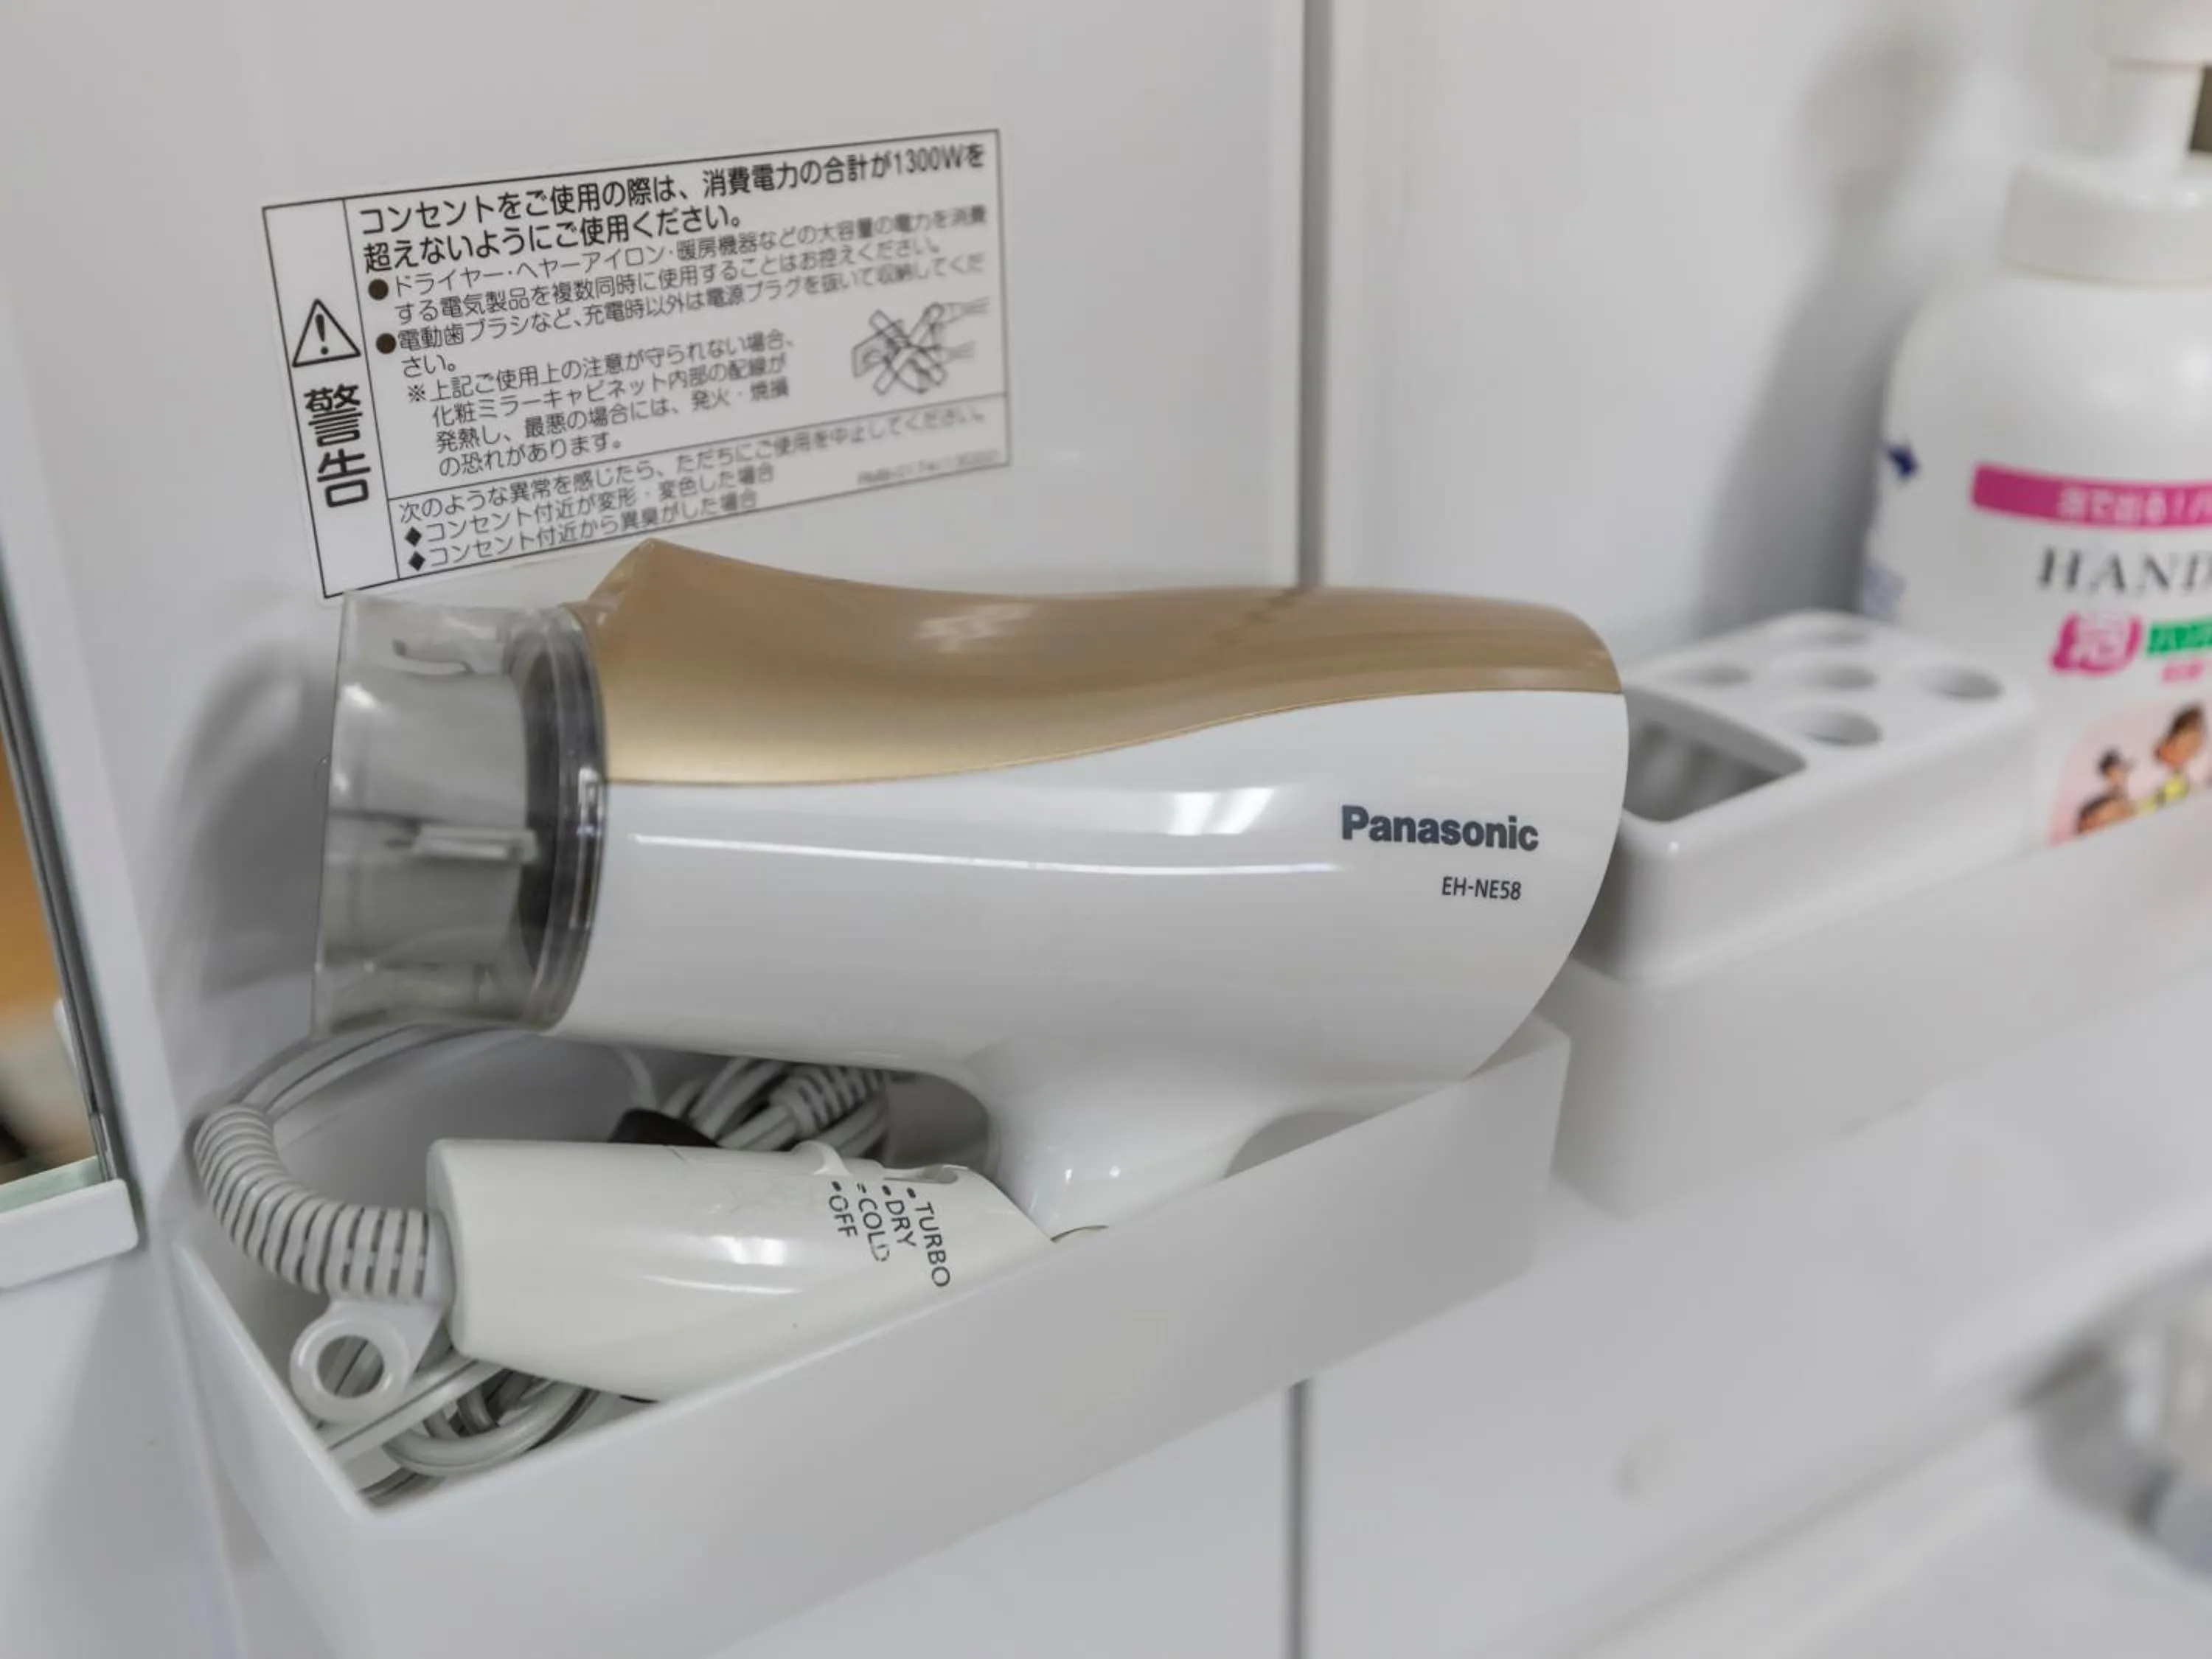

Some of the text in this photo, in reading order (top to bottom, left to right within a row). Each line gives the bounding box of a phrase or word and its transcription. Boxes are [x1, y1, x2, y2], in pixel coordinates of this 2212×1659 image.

[363, 204, 741, 274] 超えないようにご使用ください。
[303, 383, 372, 509] 警告
[439, 431, 622, 478] の恐れがあります。
[1341, 804, 1539, 852] Panasonic
[1441, 876, 1522, 900] EH-NE58
[828, 1194, 858, 1237] OFF
[858, 1197, 891, 1262] COLD
[885, 1200, 917, 1247] DRY
[915, 1201, 950, 1287] TURBO
